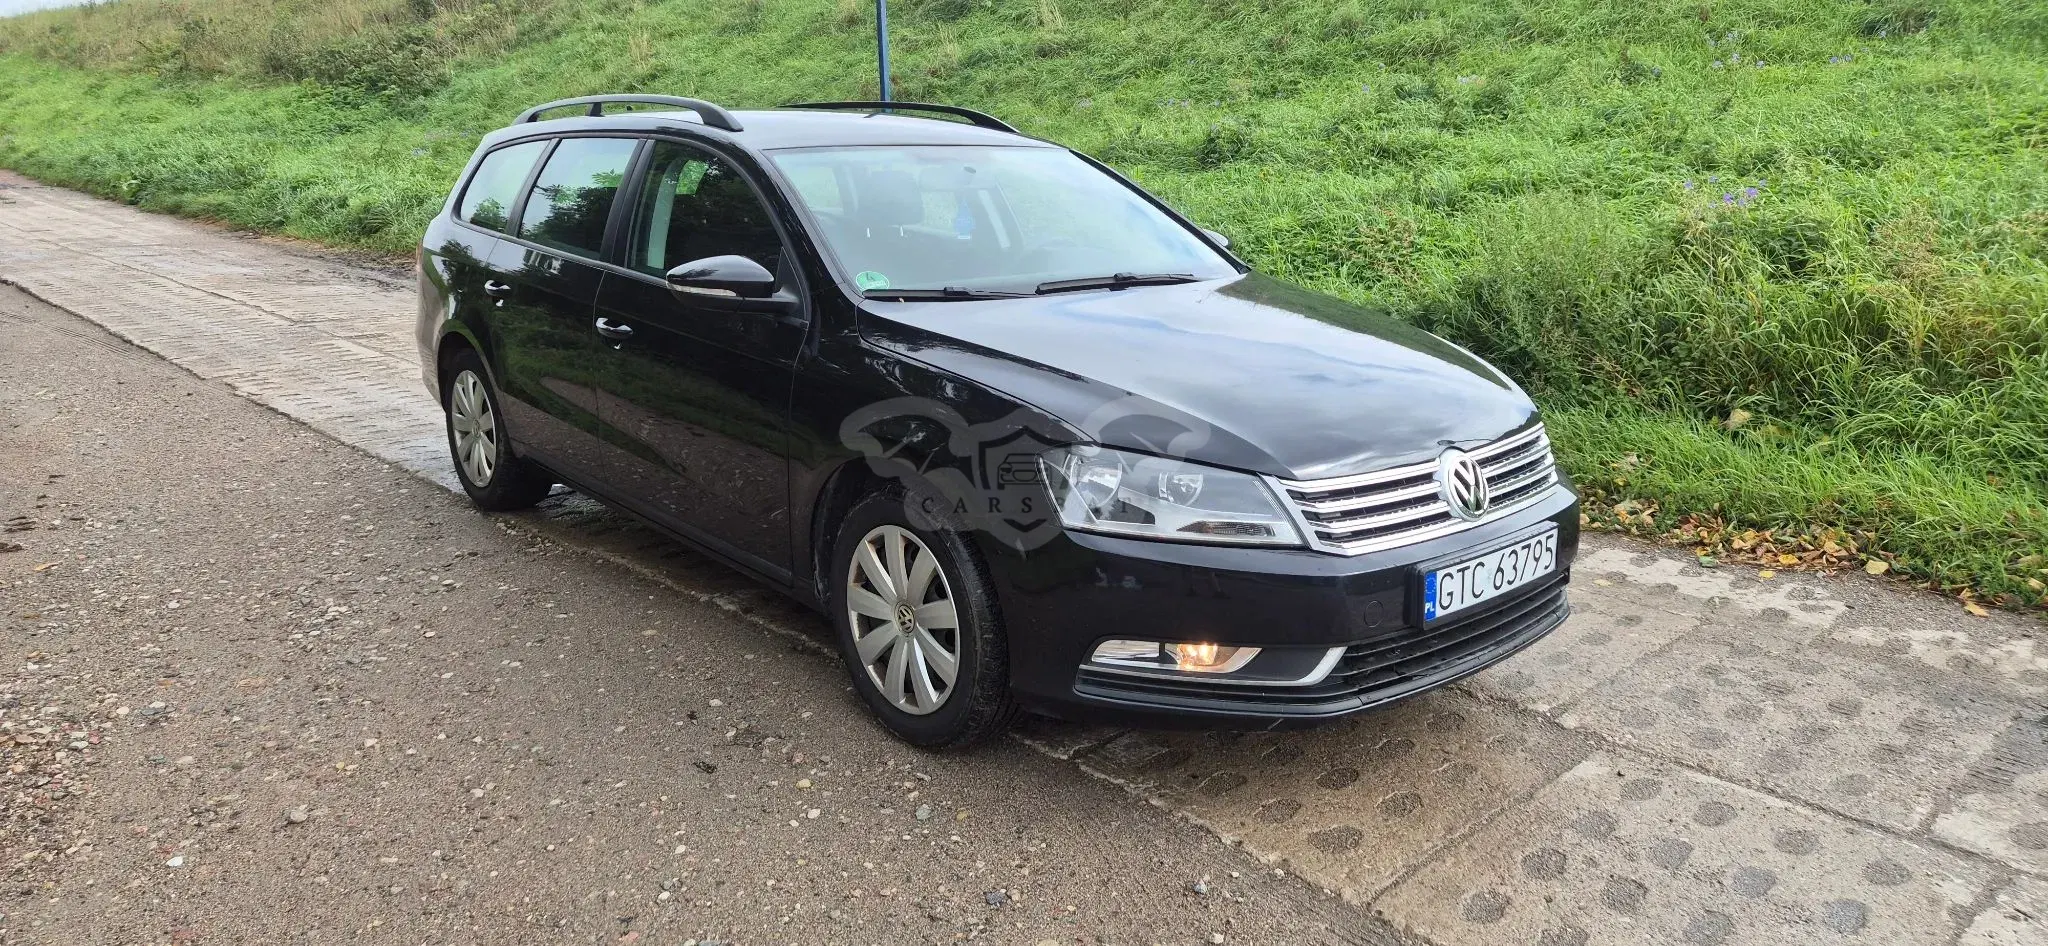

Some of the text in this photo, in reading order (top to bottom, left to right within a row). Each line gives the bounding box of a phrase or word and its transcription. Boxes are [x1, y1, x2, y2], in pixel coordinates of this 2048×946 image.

[1439, 533, 1555, 611] GTC 63795
[1424, 601, 1435, 614] PL
